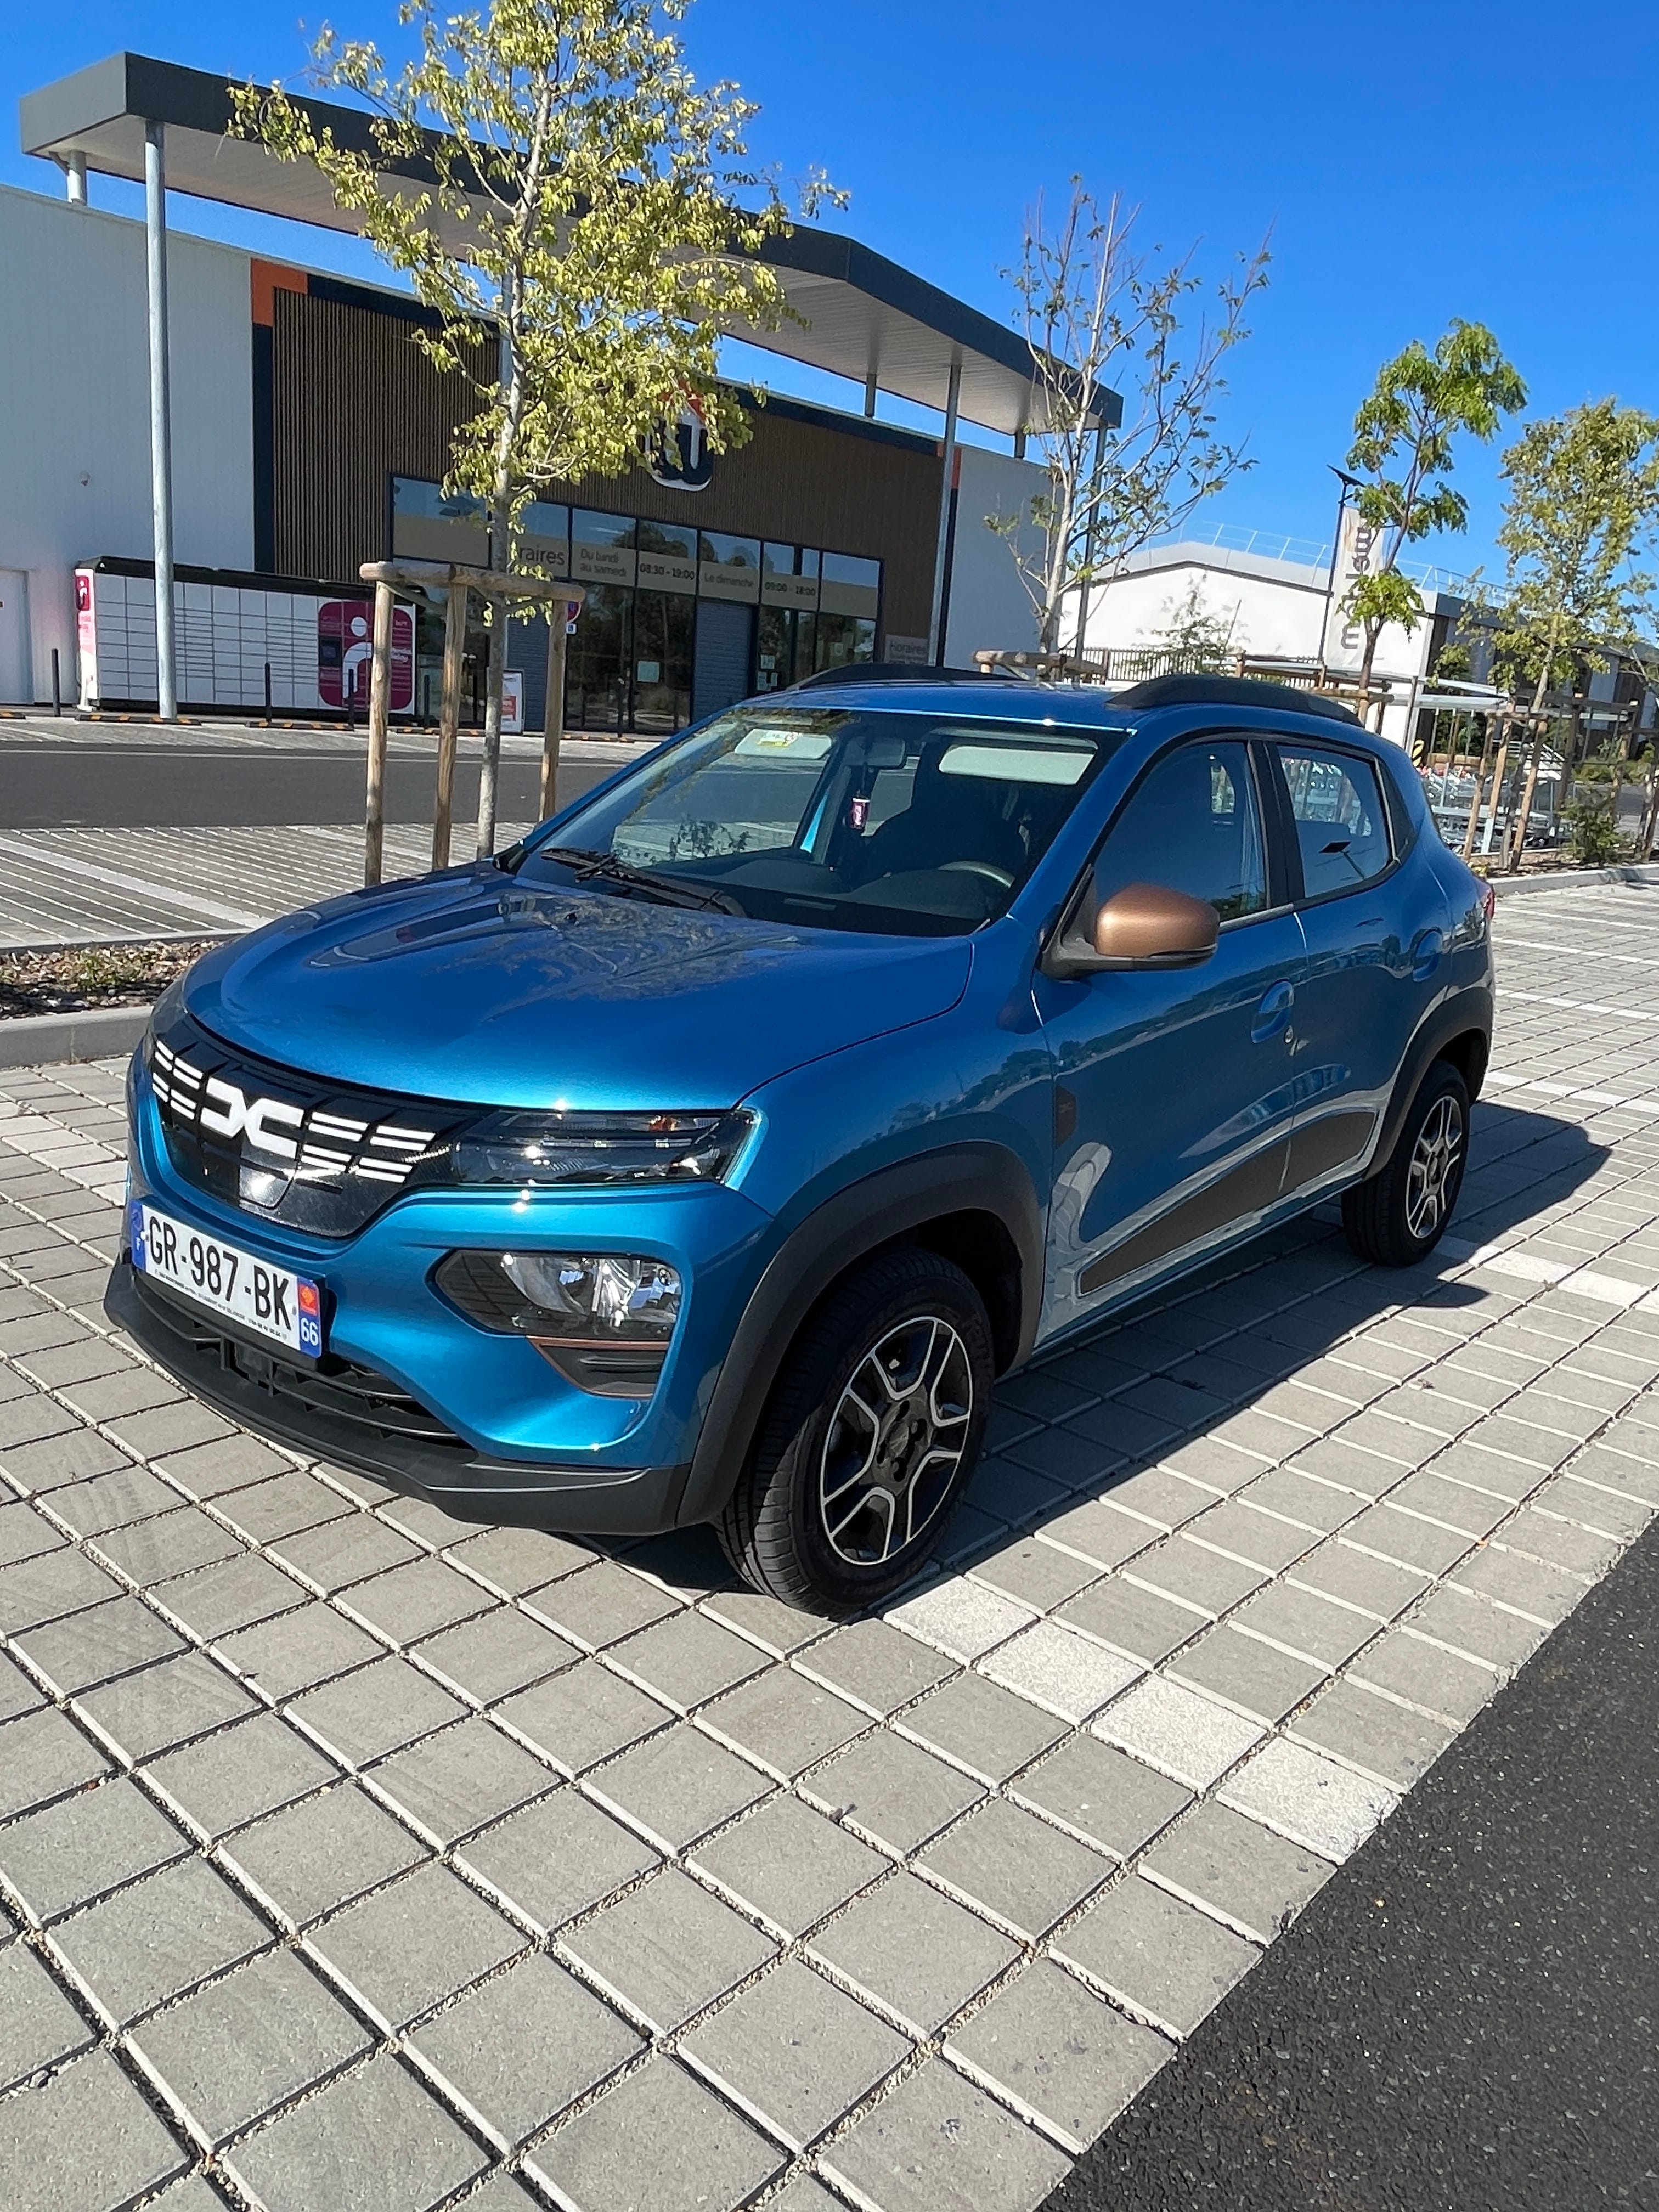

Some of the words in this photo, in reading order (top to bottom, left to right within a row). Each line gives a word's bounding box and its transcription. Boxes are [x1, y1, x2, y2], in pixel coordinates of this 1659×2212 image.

[136, 1237, 141, 1250] F
[150, 1216, 292, 1331] GR-987-BK
[301, 1318, 318, 1346] 66
